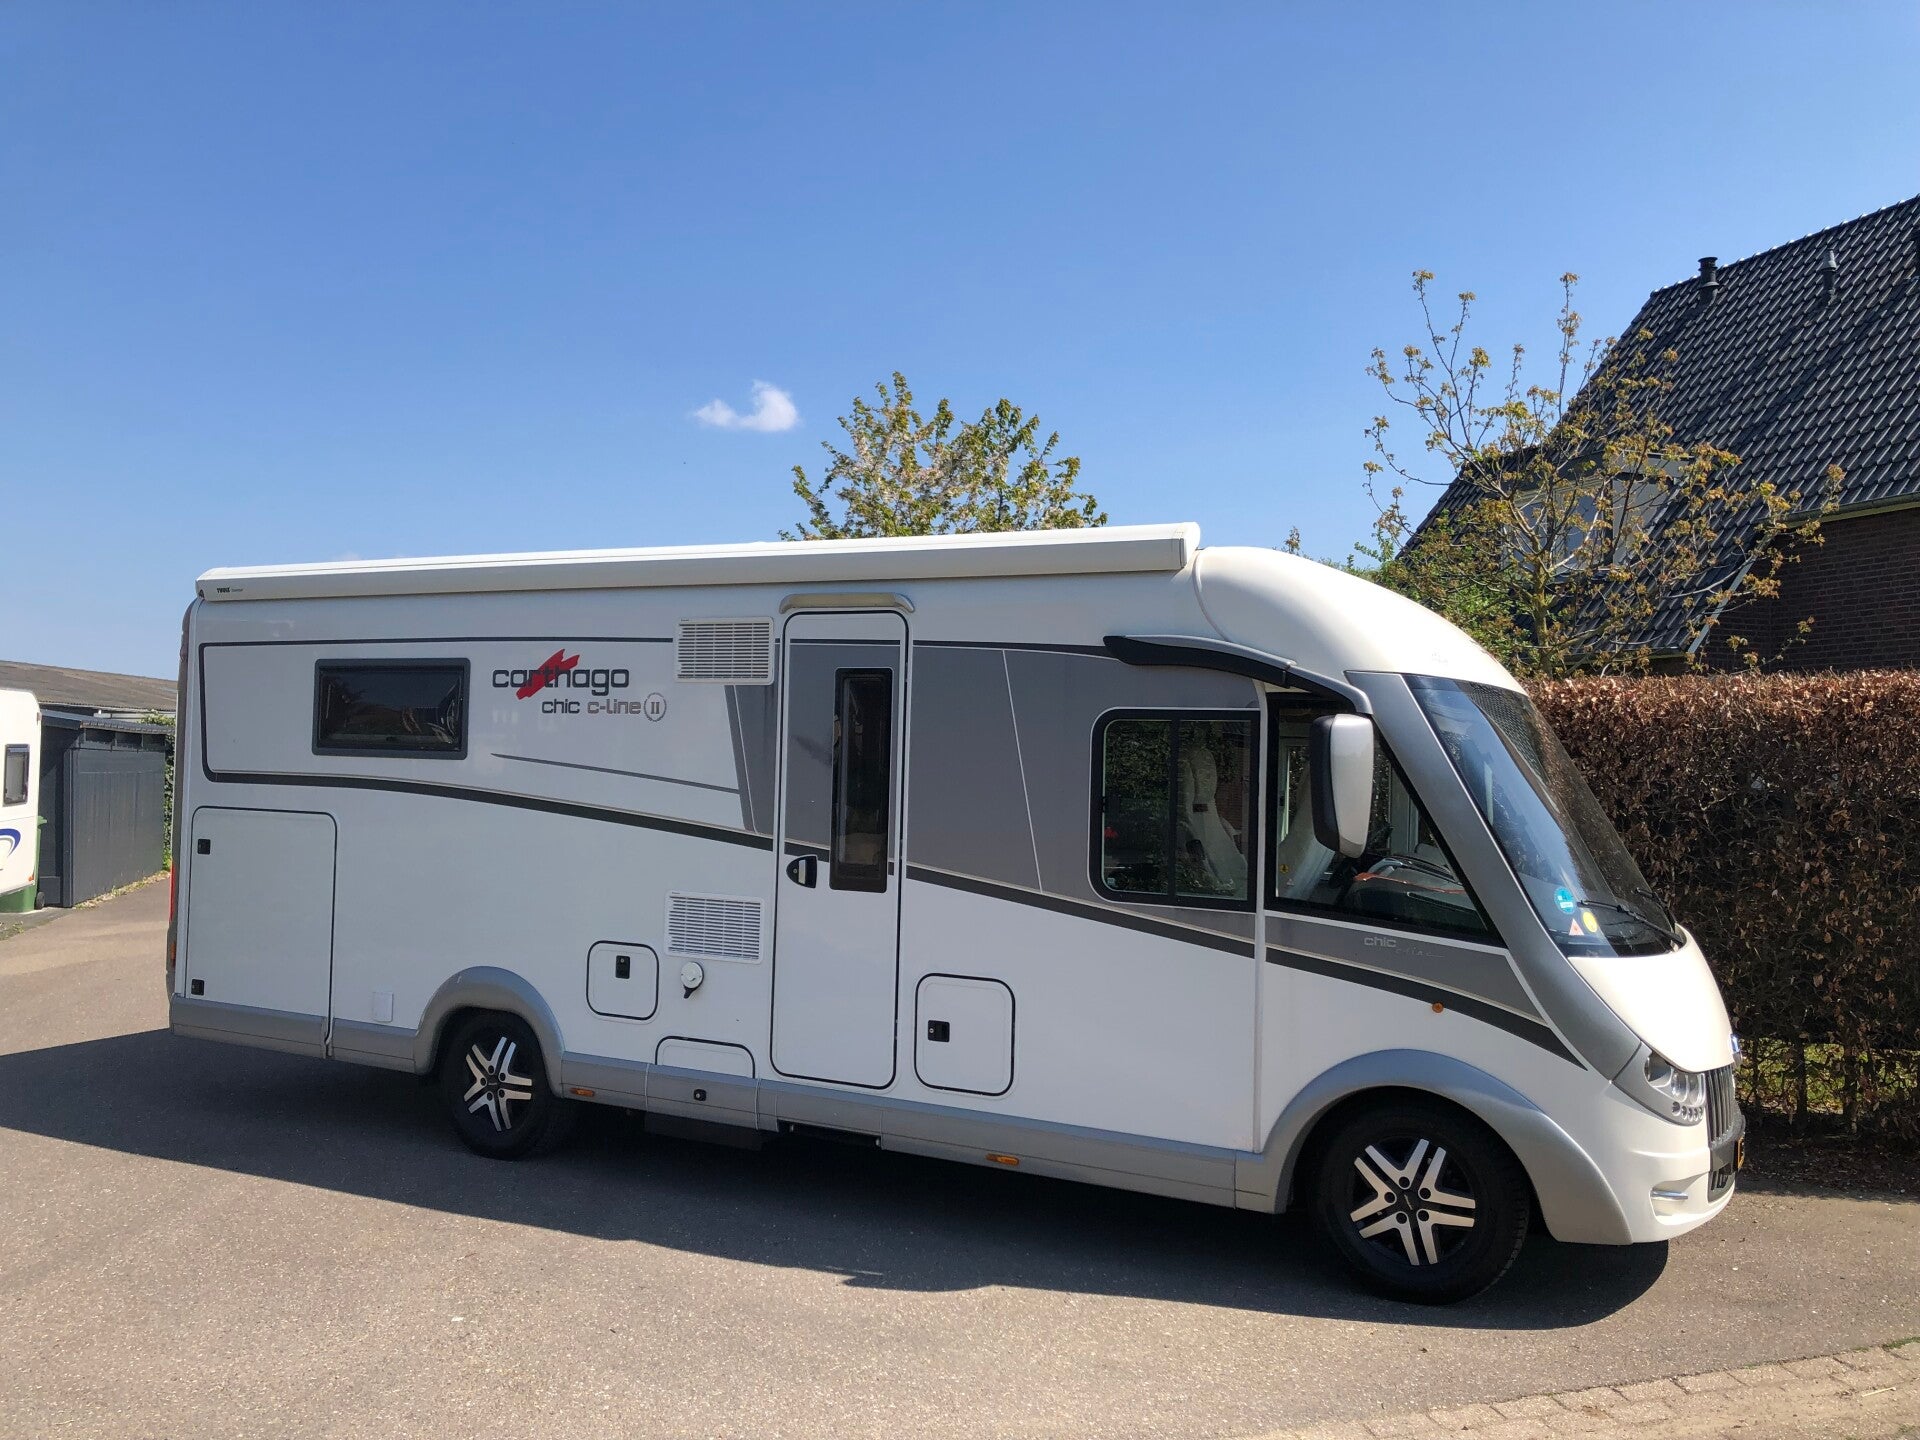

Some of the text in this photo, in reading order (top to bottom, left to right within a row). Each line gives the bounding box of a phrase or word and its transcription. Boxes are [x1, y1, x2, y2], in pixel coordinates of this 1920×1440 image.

[492, 666, 630, 697] carthago
[541, 698, 580, 715] chic
[587, 698, 642, 715] c-line
[1363, 936, 1397, 948] chic
